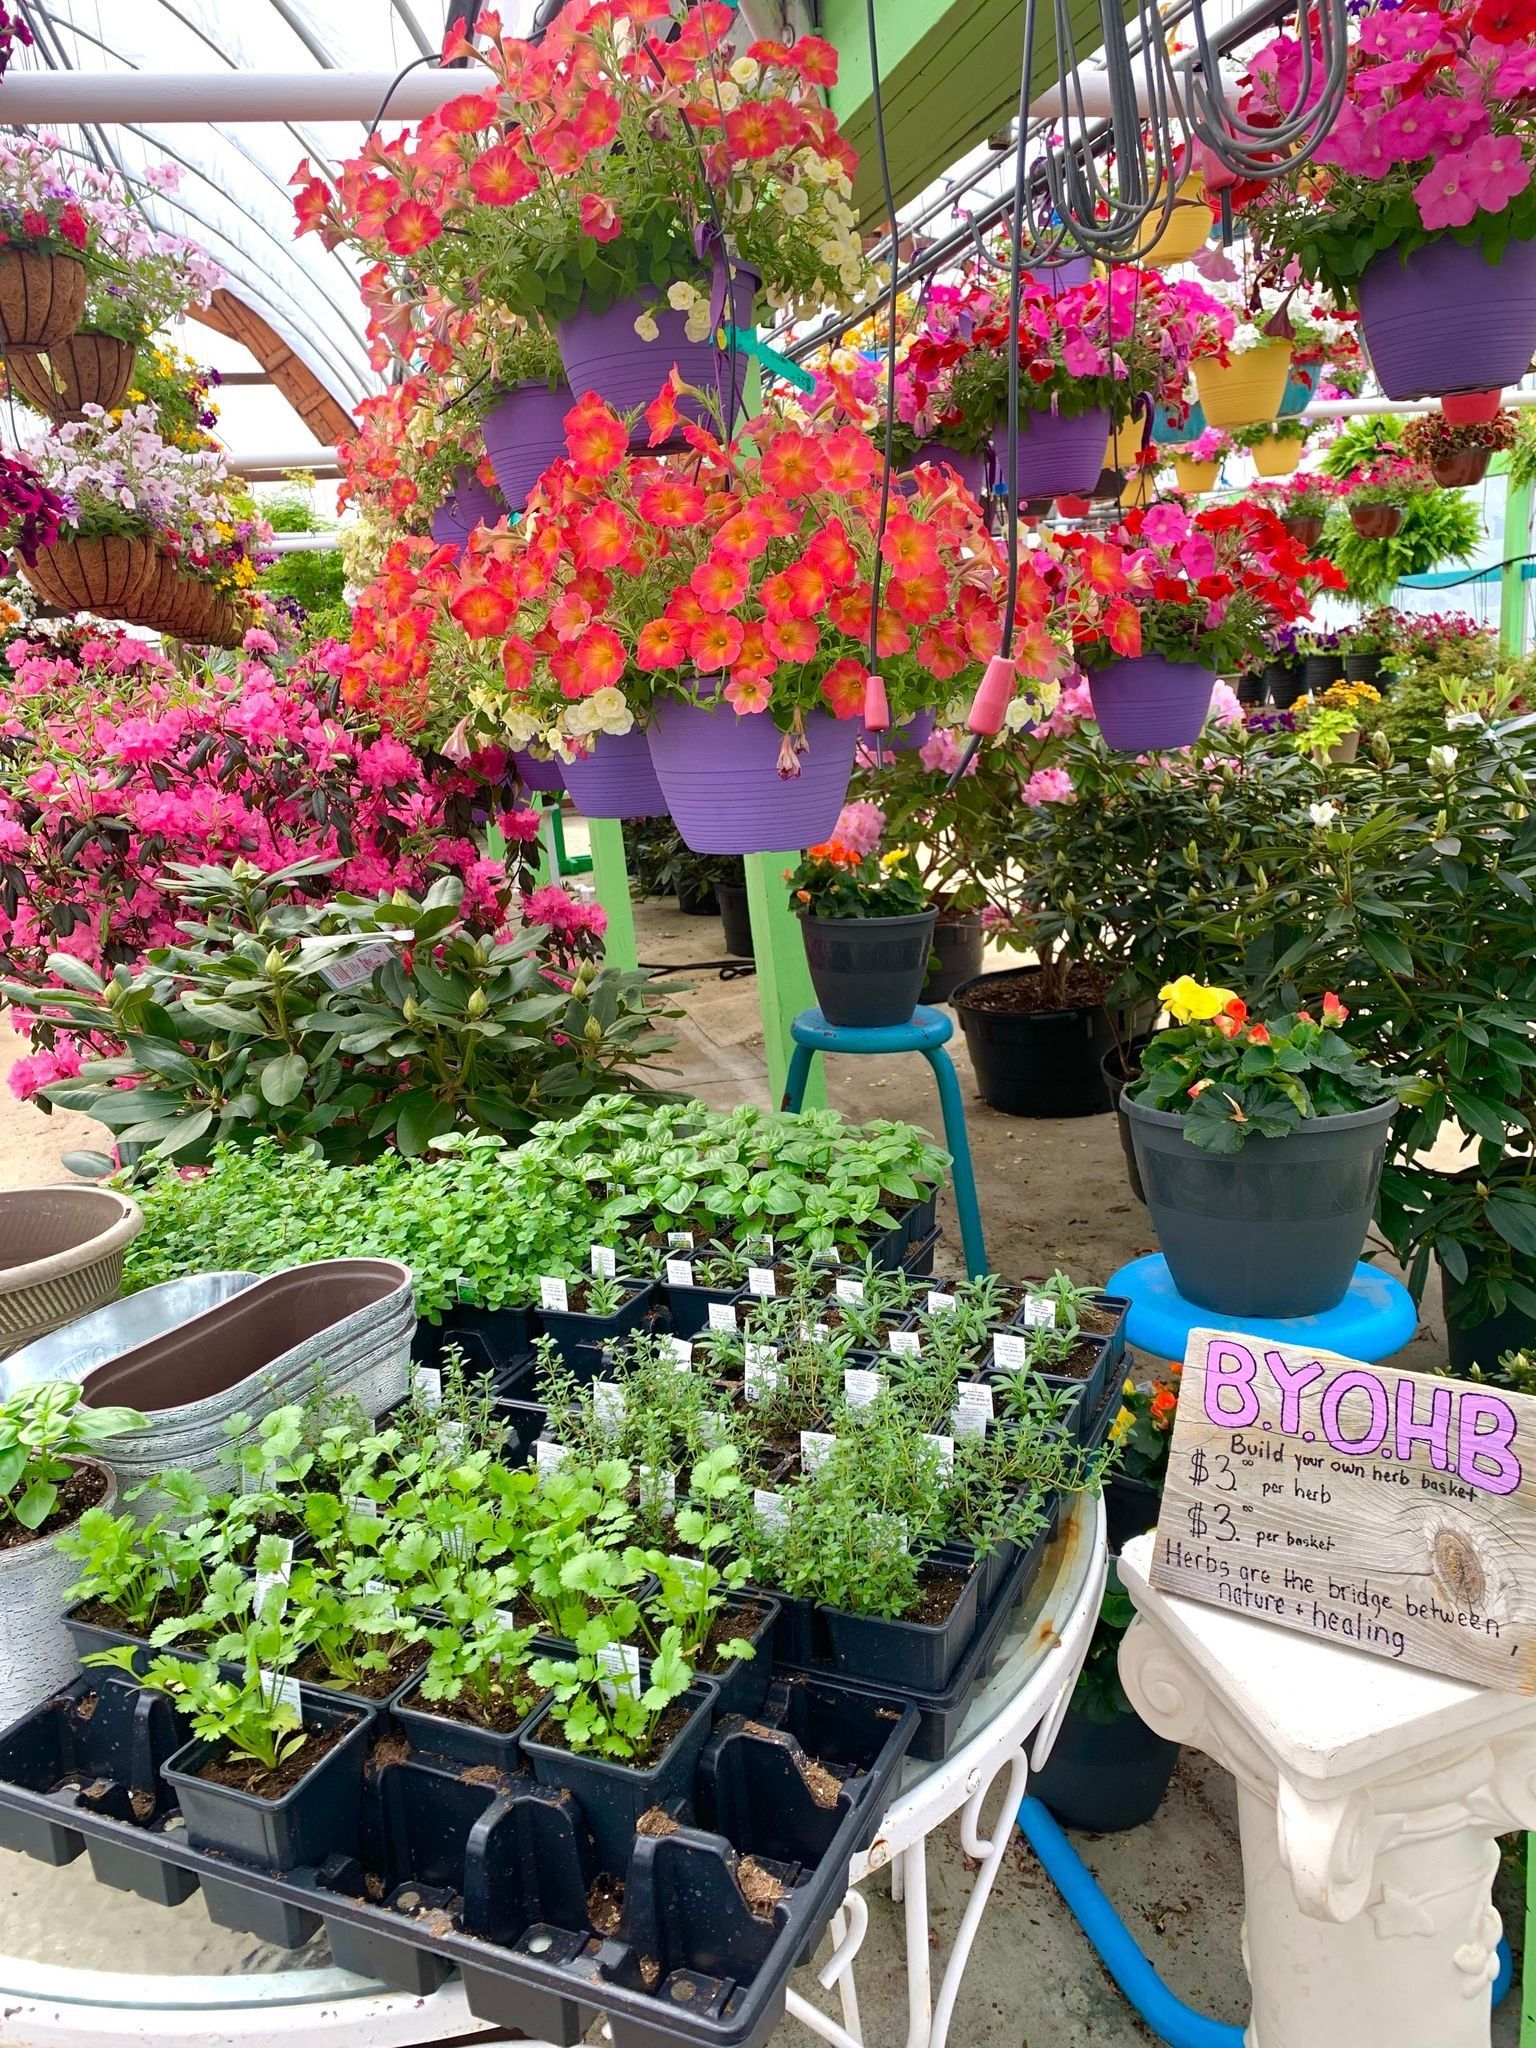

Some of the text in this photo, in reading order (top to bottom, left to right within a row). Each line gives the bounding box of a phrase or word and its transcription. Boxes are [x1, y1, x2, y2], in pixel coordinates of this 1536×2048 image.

[1230, 1434, 1478, 1503] Build your own herb basket
[1262, 1480, 1285, 1497] per
[1294, 1478, 1332, 1504] herb
[1256, 1530, 1279, 1548] per
[1287, 1532, 1336, 1551] basket
[1165, 1538, 1501, 1638] Herbs are the bridge between
[1218, 1581, 1405, 1657] nature + healing
